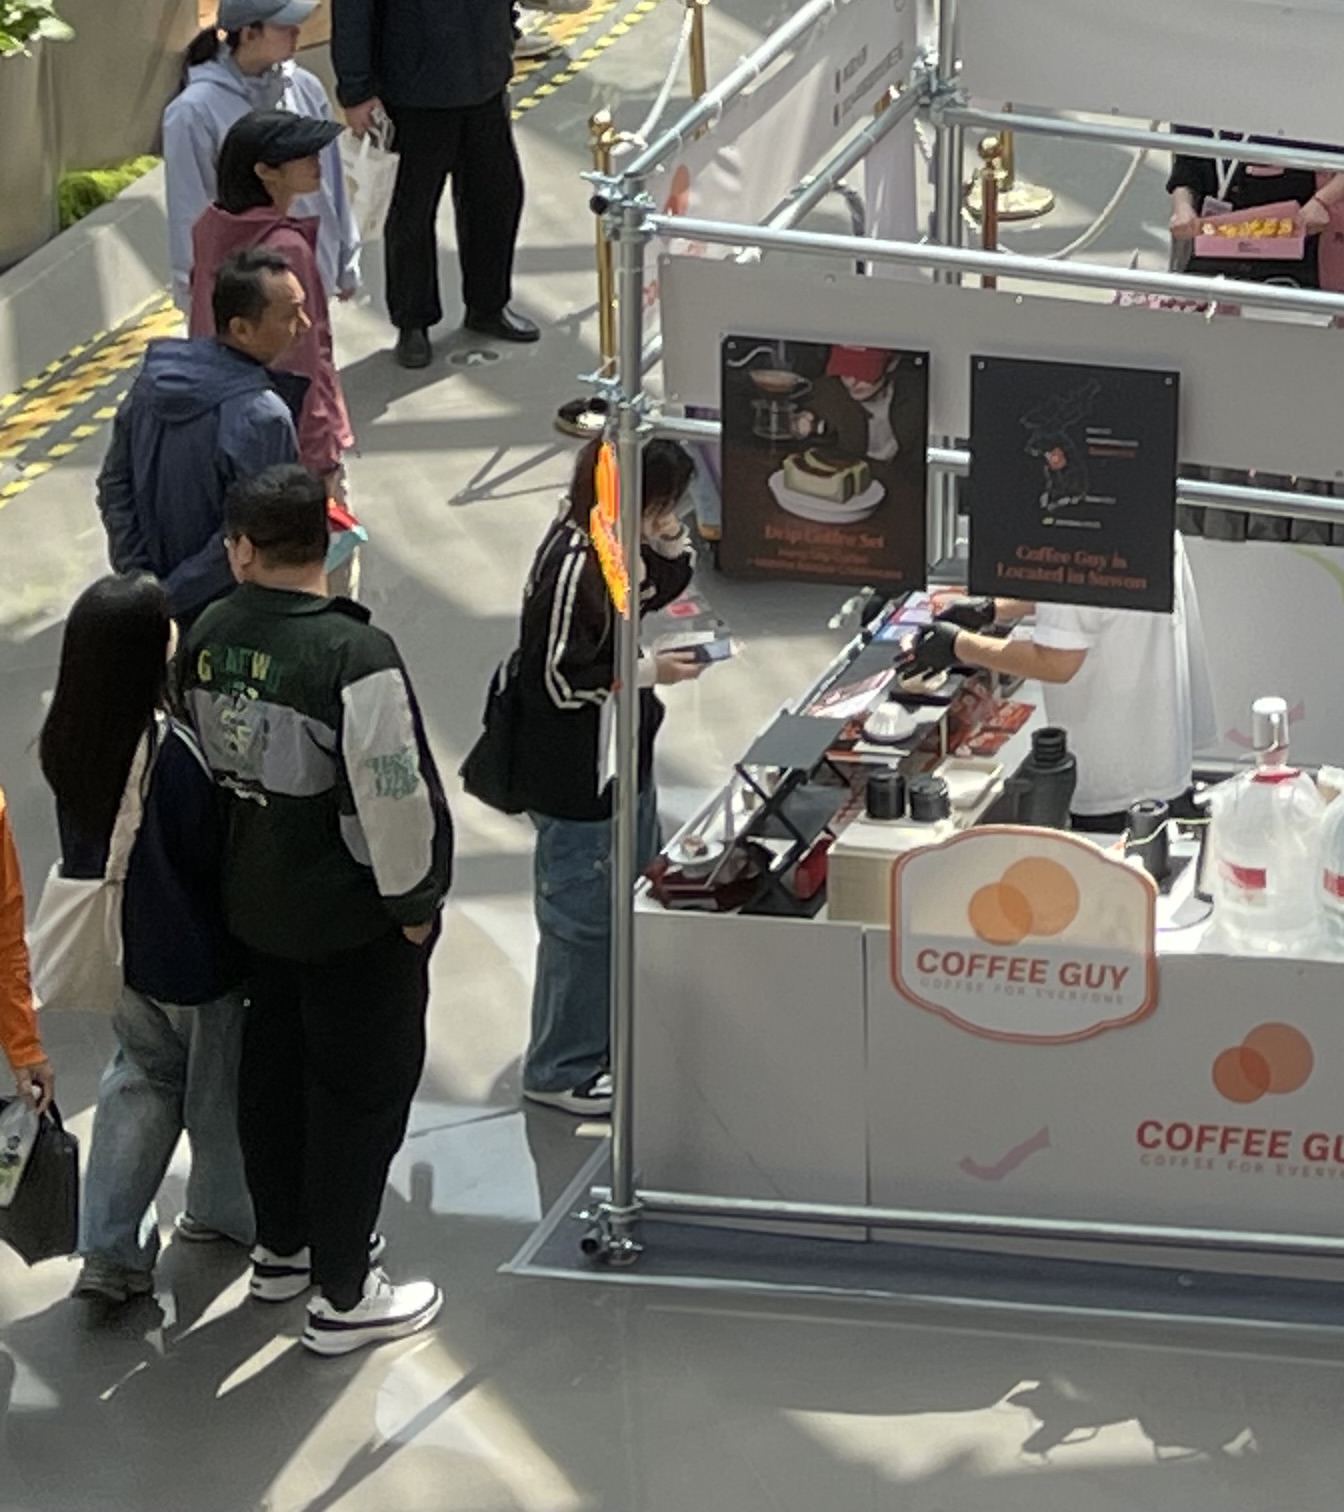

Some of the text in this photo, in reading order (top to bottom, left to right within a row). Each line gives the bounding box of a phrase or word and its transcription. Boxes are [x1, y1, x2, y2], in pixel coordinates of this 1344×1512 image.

[1015, 544, 1071, 564] Coffee
[1073, 549, 1107, 569] Guy
[995, 561, 1065, 583] Located
[916, 947, 1130, 992] COFFEE GUY
[919, 976, 1125, 1006] COFFEE FOR EVERYONE
[1136, 1119, 1293, 1160] COFFEE
[1139, 1152, 1216, 1172] COFFEE
[1226, 1158, 1265, 1175] FOR
